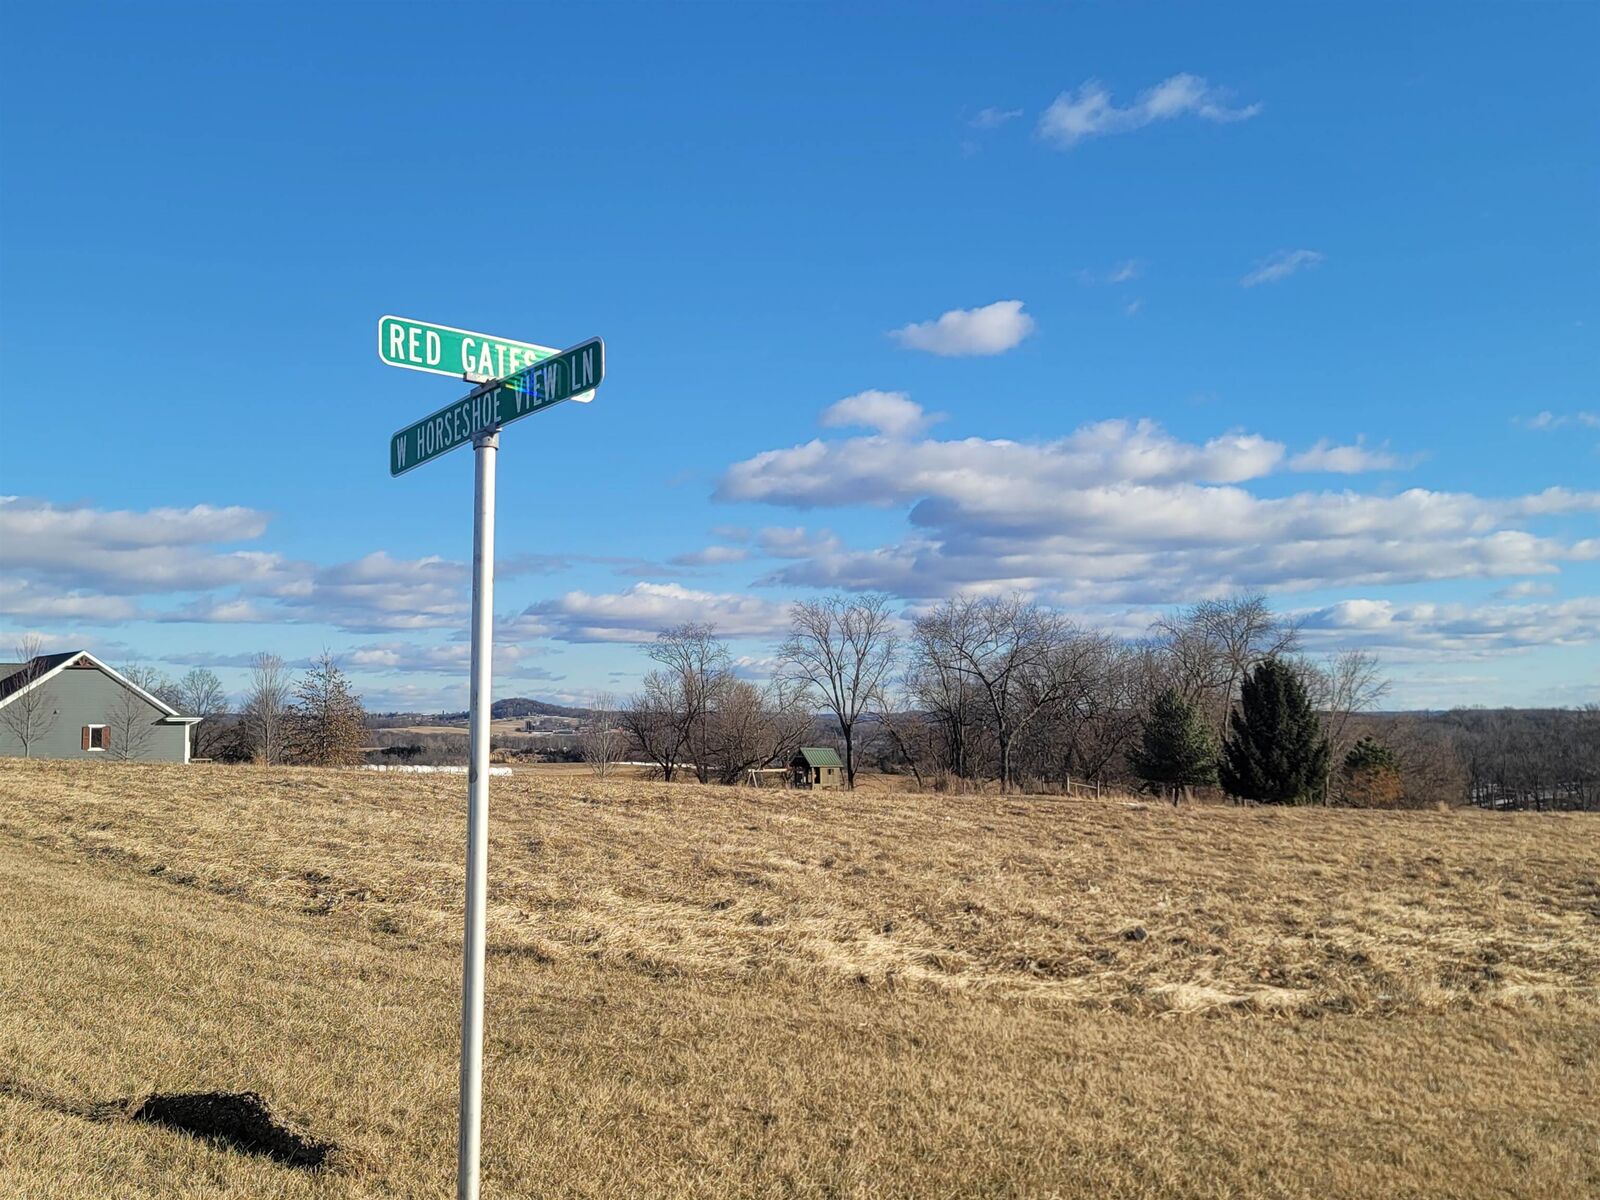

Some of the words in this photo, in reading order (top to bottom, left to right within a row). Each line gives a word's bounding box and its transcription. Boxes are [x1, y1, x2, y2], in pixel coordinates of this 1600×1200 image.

[390, 323, 441, 365] RED
[397, 435, 407, 469] W
[417, 388, 502, 459] HORSESHOE
[514, 363, 557, 413] VIEW
[571, 348, 593, 391] LN
